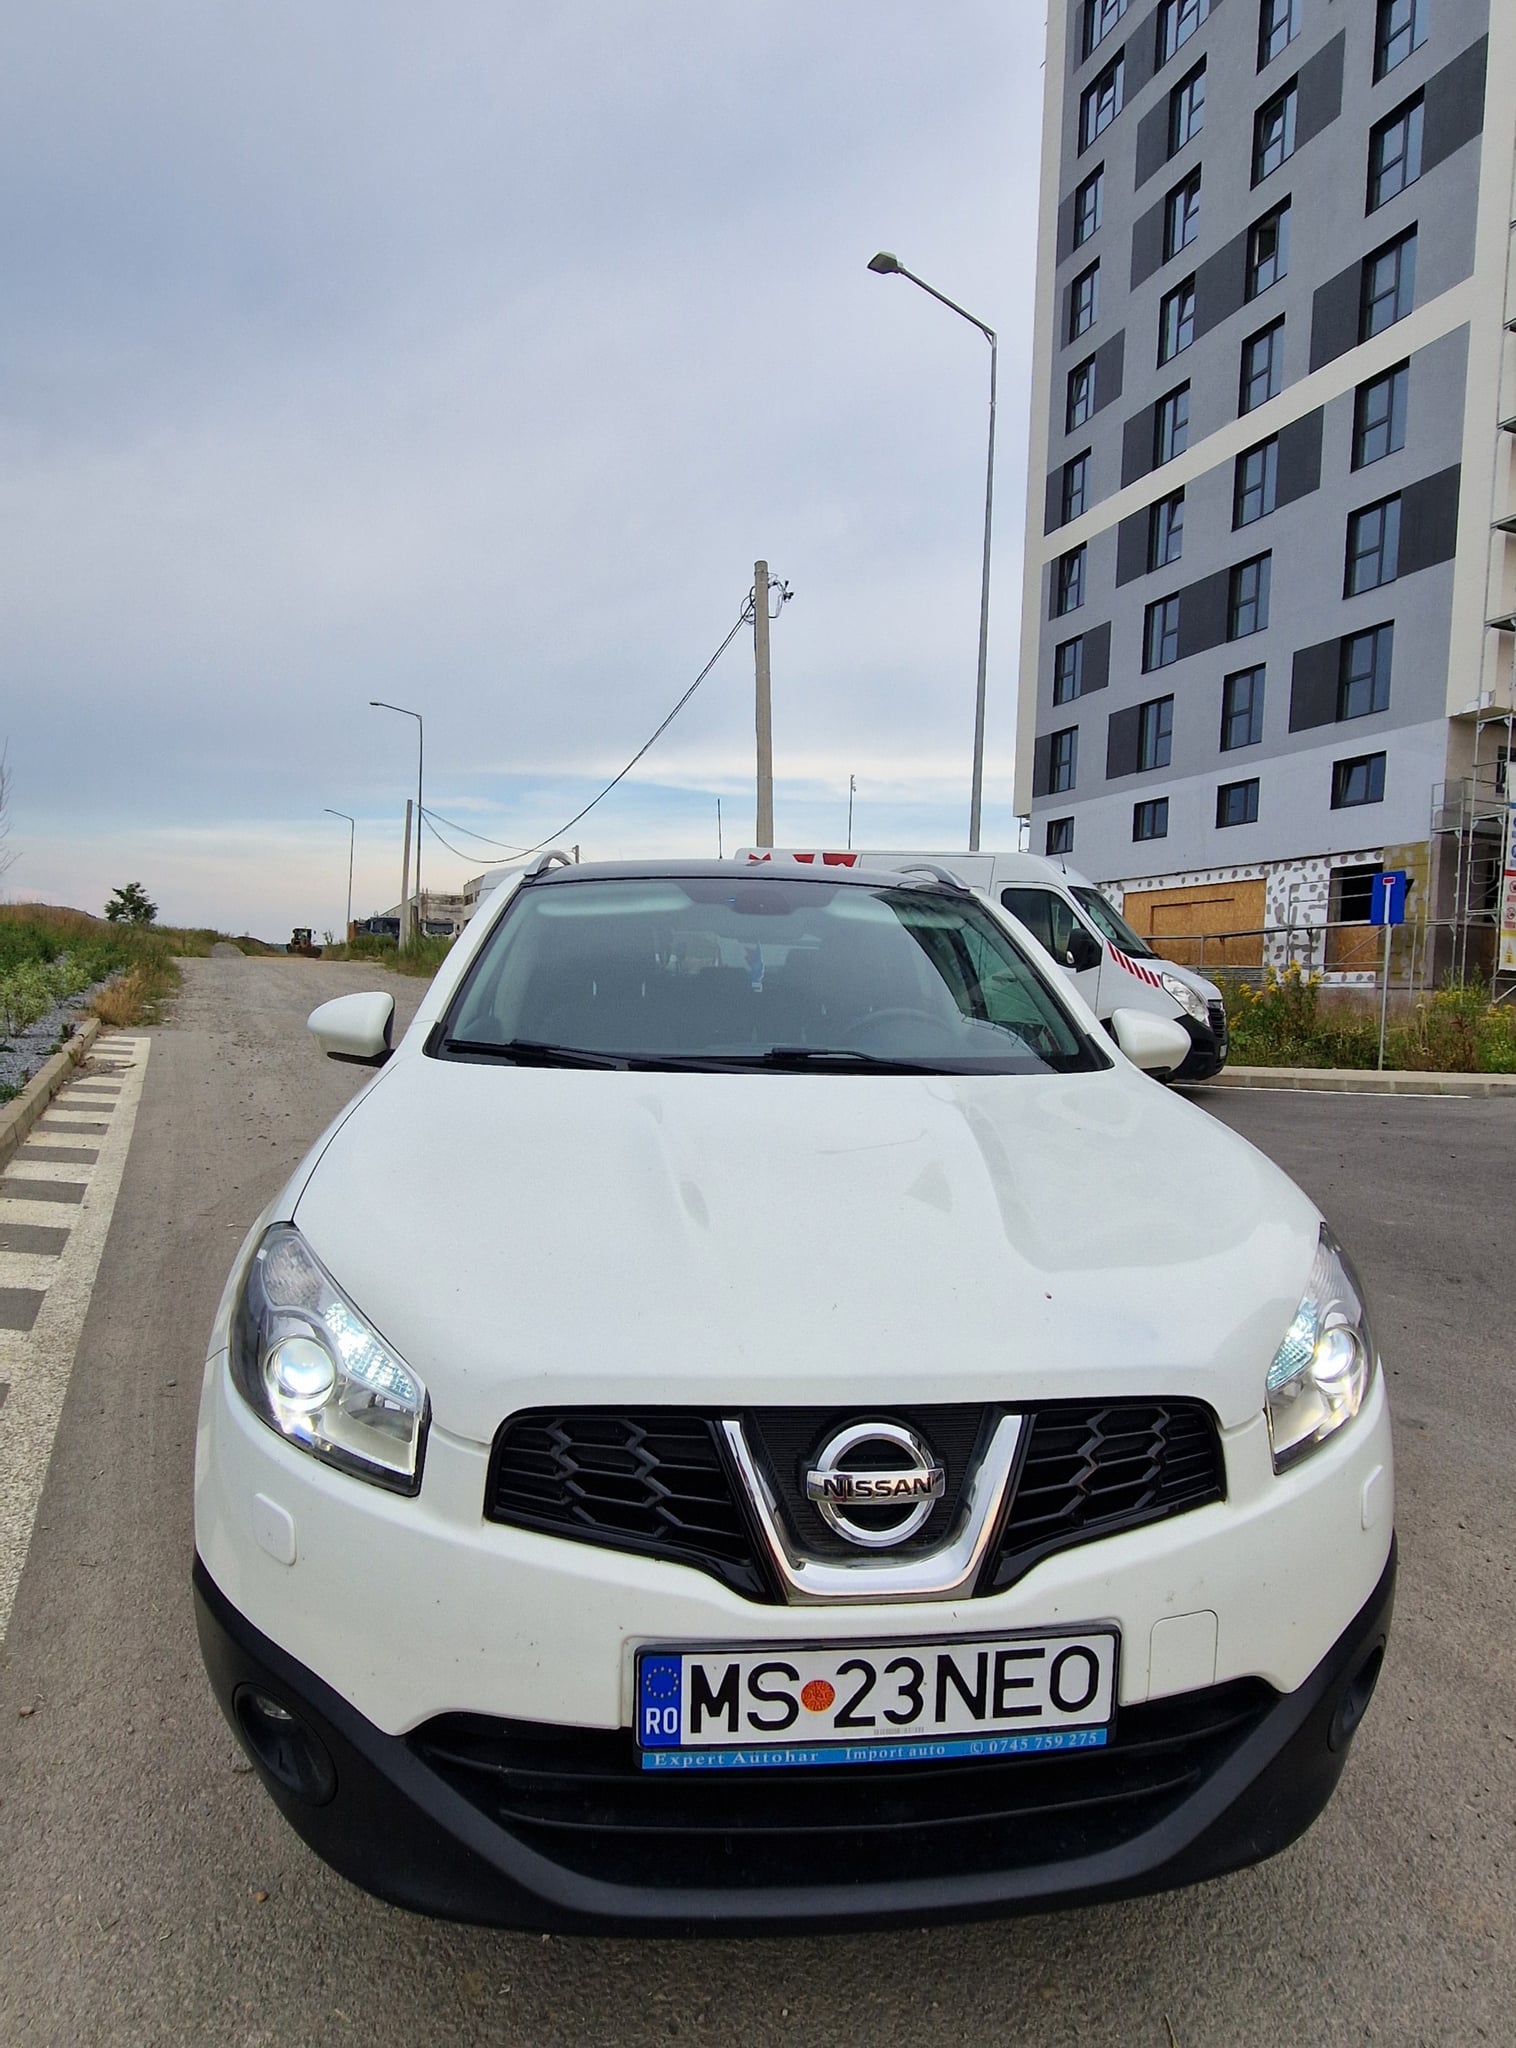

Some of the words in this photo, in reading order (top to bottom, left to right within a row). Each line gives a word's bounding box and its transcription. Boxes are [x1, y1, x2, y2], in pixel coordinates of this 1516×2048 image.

[823, 1476, 933, 1498] NISSAN
[645, 1707, 679, 1735] RO
[654, 1752, 724, 1768] Expert
[732, 1751, 819, 1764] Autohar
[844, 1747, 903, 1761] Import
[908, 1744, 946, 1757] auto
[988, 1735, 1028, 1753] 0745
[1034, 1734, 1063, 1750] 759
[1069, 1731, 1098, 1747] 275
